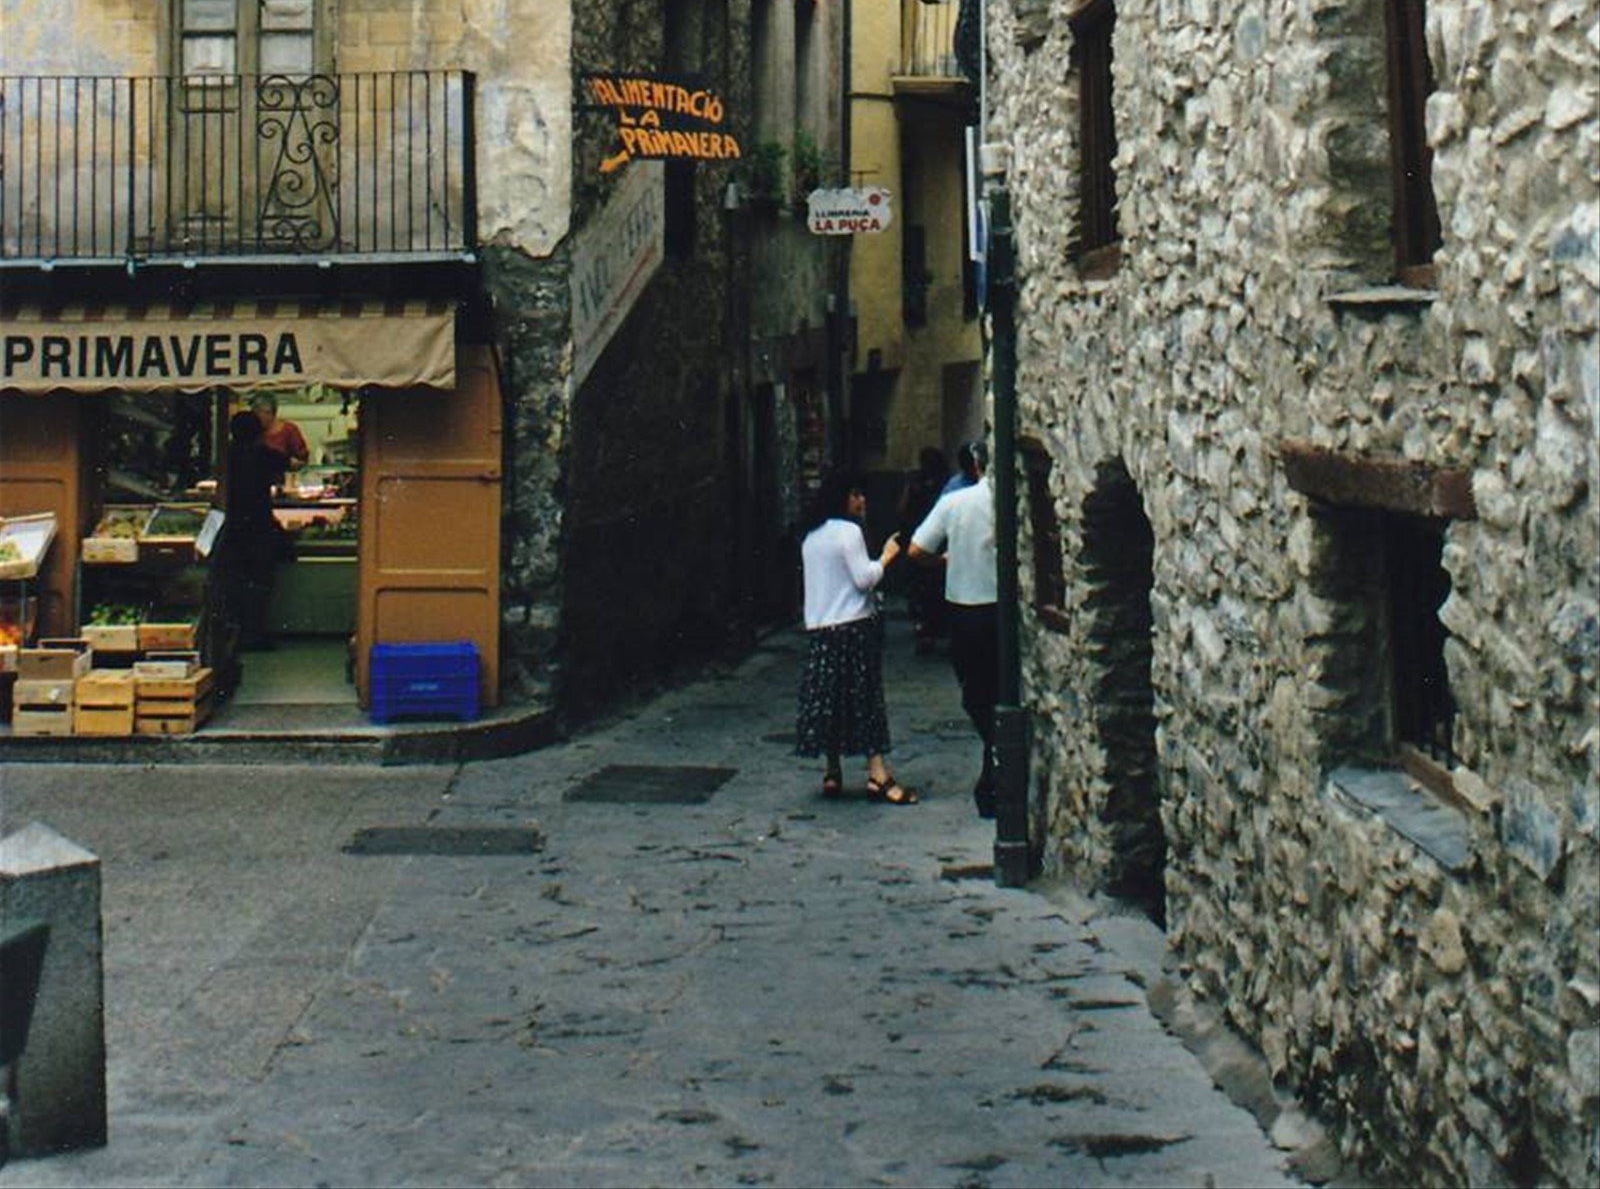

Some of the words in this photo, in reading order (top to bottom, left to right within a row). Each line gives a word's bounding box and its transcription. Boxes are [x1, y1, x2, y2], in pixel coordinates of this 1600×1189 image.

[620, 110, 660, 127] LA
[815, 219, 834, 231] LA
[4, 333, 303, 377] PRIMAVERA
